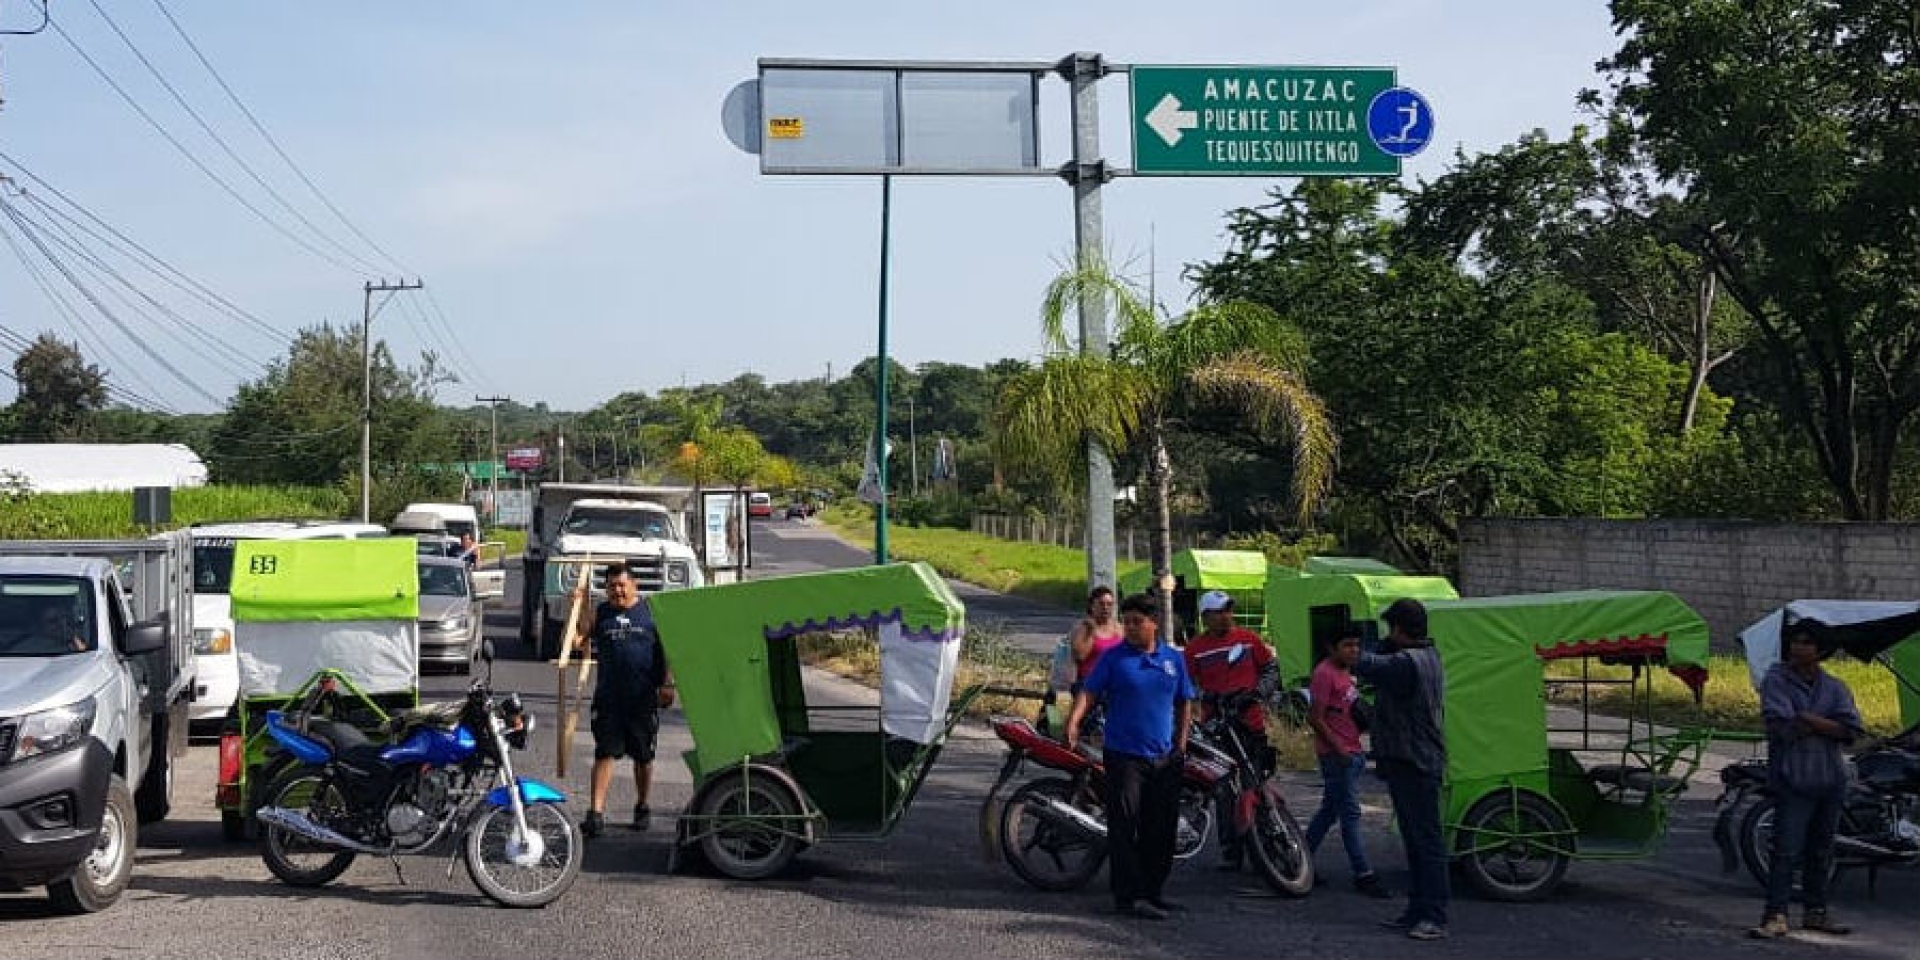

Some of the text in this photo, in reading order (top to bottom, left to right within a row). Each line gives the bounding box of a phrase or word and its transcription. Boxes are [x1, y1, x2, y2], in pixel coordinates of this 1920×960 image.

[1204, 79, 1356, 101] AMACUZAC
[1204, 109, 1358, 132] PUENTE DE IXTLA
[1206, 140, 1359, 163] TEQUESQUITENGO
[251, 555, 276, 574] 35
